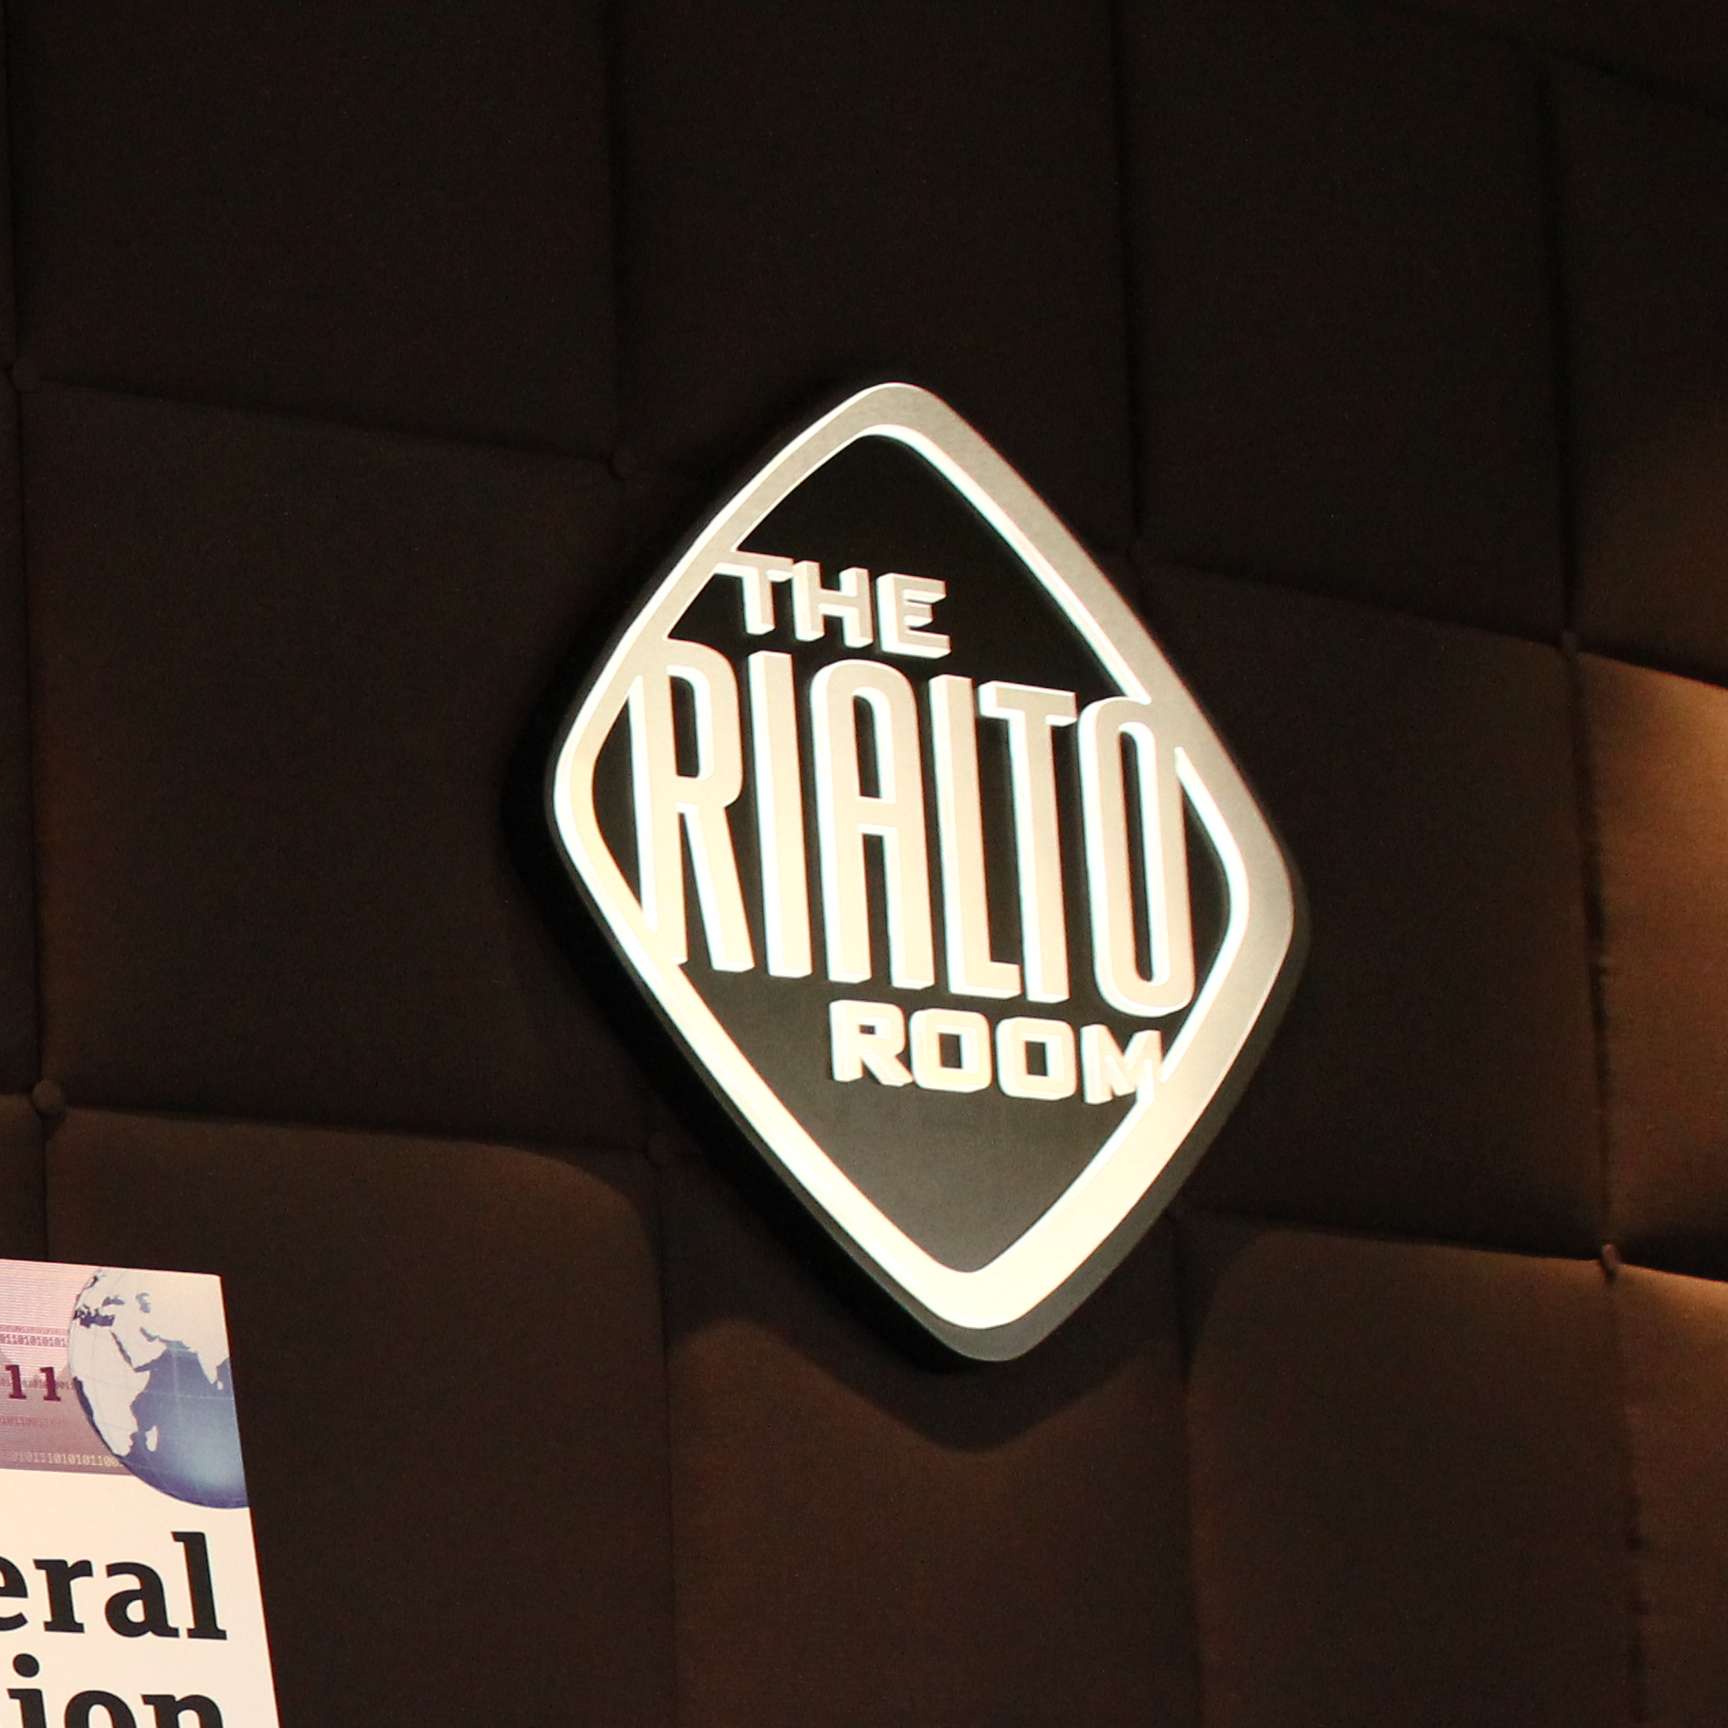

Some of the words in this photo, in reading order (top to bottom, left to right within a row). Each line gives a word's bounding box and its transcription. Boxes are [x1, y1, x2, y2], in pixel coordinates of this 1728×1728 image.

[716, 549, 951, 659] THE
[628, 637, 1196, 1017] RIALTO
[829, 999, 1164, 1104] ROOM
